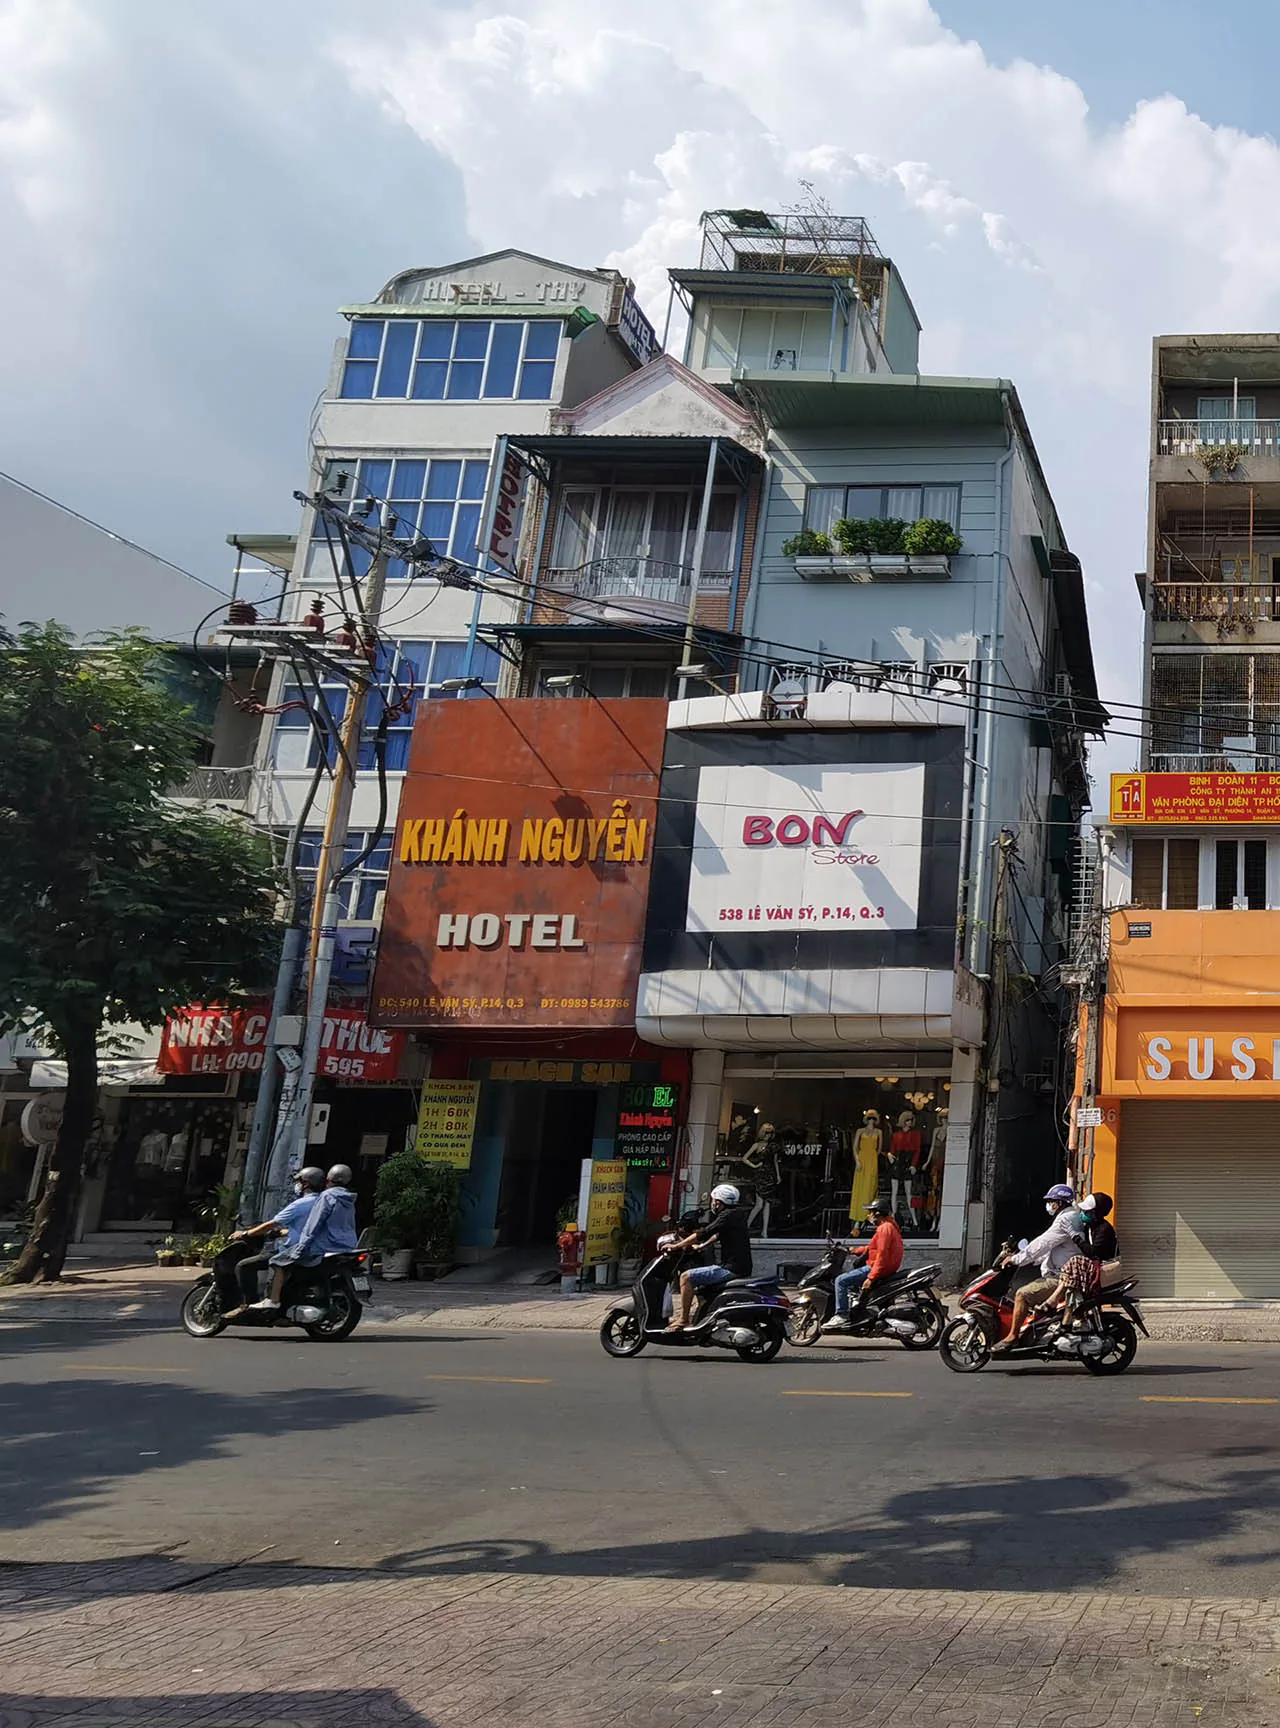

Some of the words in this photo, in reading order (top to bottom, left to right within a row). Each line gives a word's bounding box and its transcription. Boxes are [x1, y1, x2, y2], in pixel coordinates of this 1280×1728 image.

[623, 296, 652, 352] HOTEL
[1218, 775, 1245, 786] ĐOÀN
[1250, 777, 1258, 785] 11
[1190, 786, 1212, 796] CÔNG
[1230, 786, 1256, 796] THÀNH
[1152, 797, 1170, 806] VĂN
[1172, 797, 1206, 806] PHÒNG
[1208, 797, 1225, 808] ĐẠI
[1227, 797, 1249, 808] DIỆN
[400, 809, 508, 862] KHÁNH
[519, 799, 648, 862] NGUYỄN
[742, 809, 864, 846] BON
[811, 849, 880, 866] Store
[719, 908, 742, 921] 538
[748, 905, 761, 921] LÊ
[766, 905, 793, 920] VĂN
[860, 906, 885, 921] Q.3
[436, 913, 585, 948] HOTEL
[399, 998, 419, 1008] 540
[423, 997, 436, 1008] LÊ
[439, 997, 459, 1008] VĂN
[324, 1056, 365, 1076] 595
